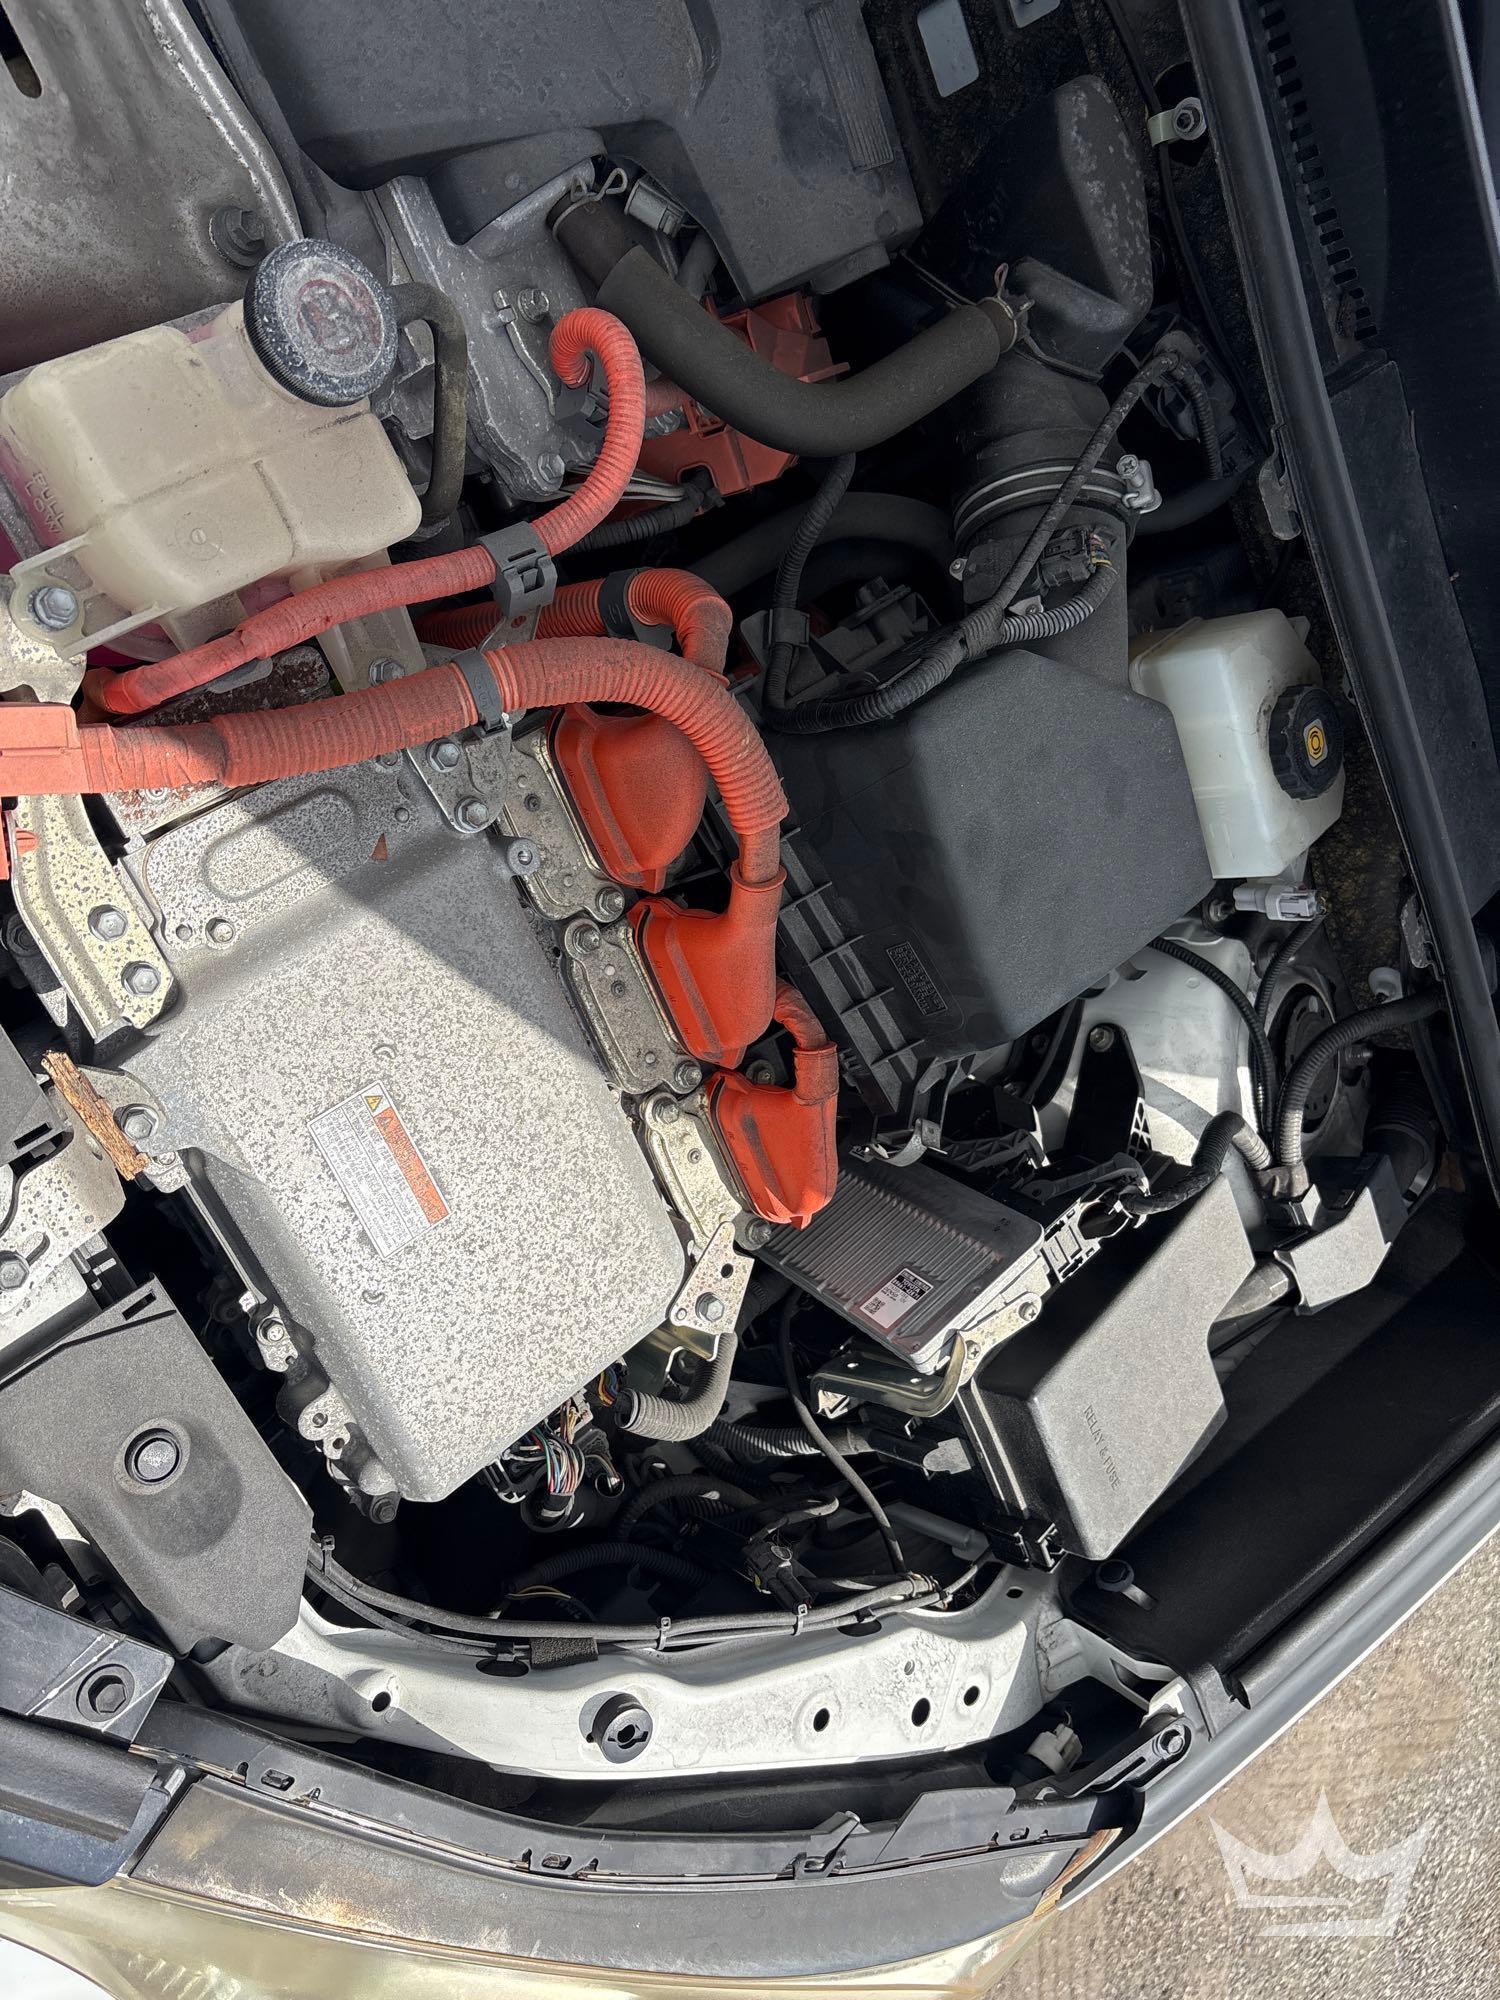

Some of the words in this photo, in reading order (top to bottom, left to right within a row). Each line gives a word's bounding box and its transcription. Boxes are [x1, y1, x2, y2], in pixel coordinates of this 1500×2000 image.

[25, 481, 62, 534] LOW
[33, 472, 64, 532] FULL
[900, 1278, 920, 1293] TOYOTA
[1083, 1404, 1105, 1446] RELAY
[1103, 1455, 1121, 1491] FUSE
